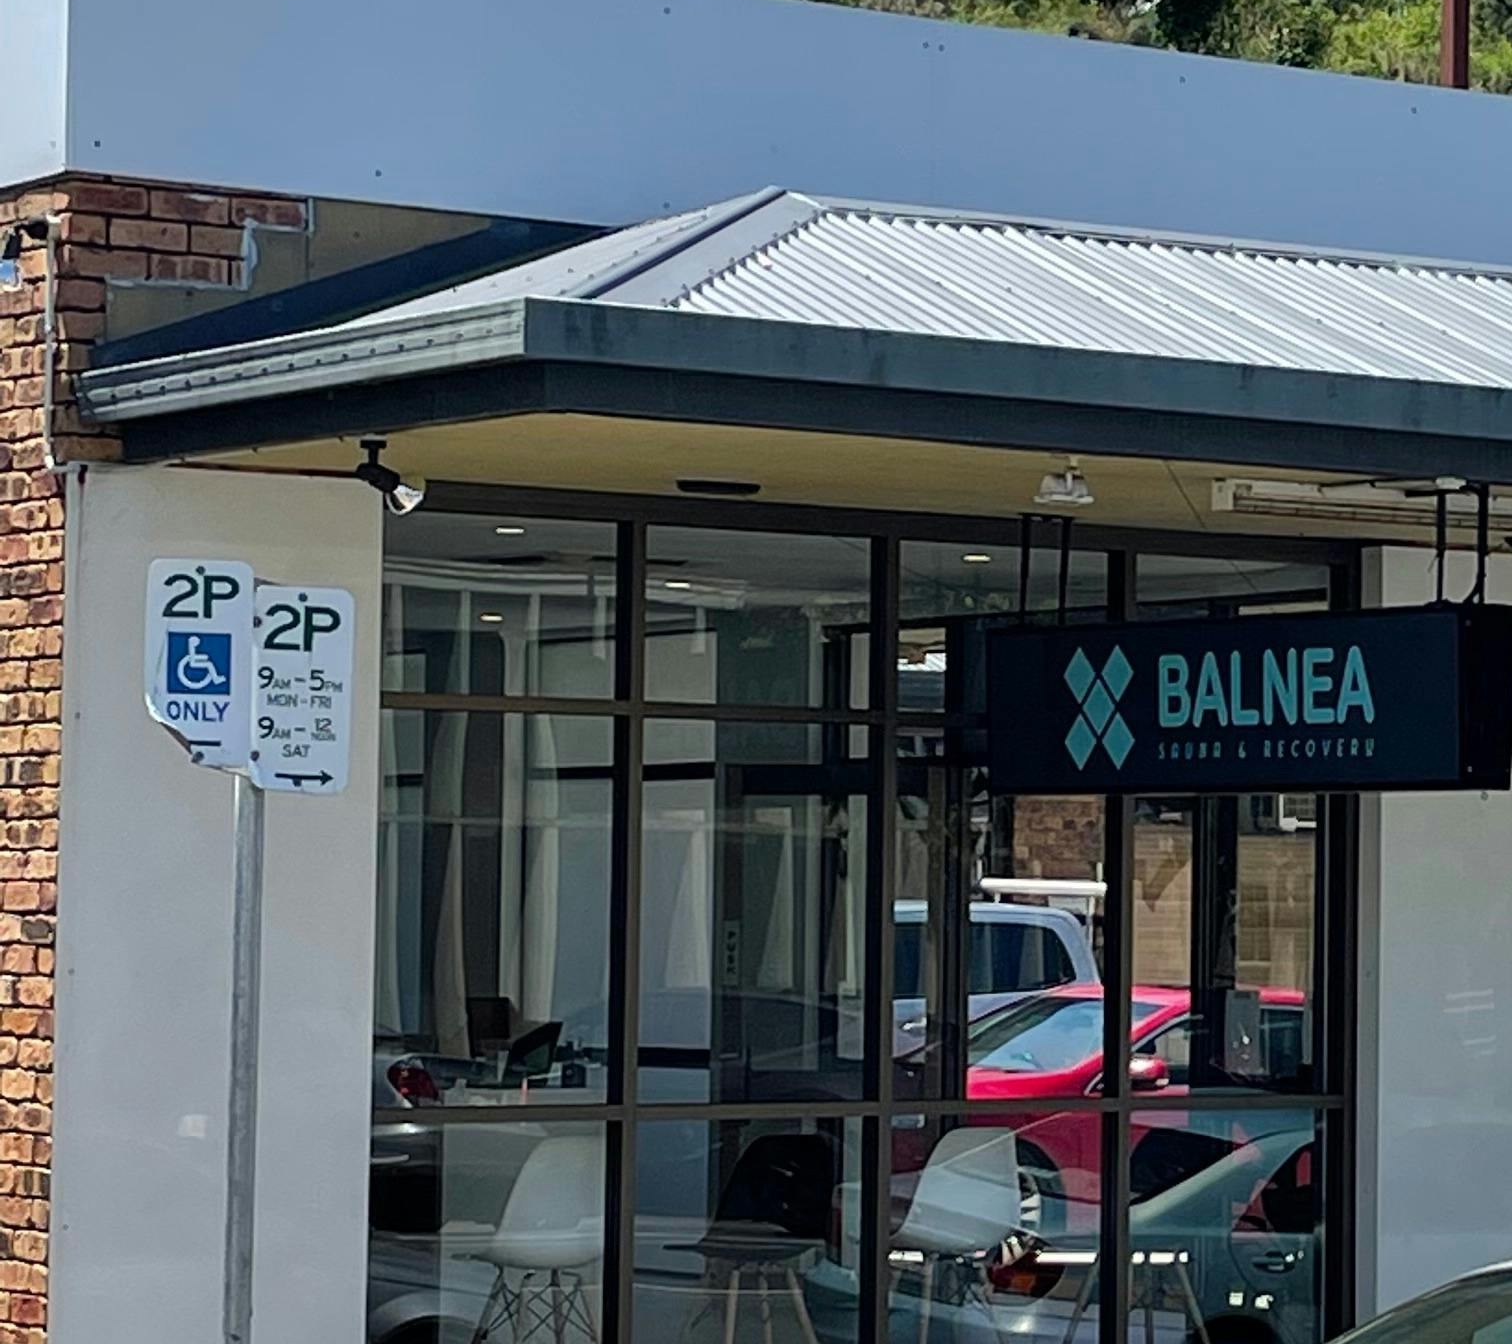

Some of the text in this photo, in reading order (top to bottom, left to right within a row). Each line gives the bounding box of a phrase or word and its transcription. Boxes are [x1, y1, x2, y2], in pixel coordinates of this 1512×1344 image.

[162, 573, 240, 619] 2P
[264, 603, 341, 652] 2P
[1158, 645, 1376, 729] BALNEA
[166, 700, 230, 722] ONLY
[282, 744, 311, 758] SAT
[1158, 740, 1222, 760] SAUNA
[1264, 737, 1376, 758] RECOVERY
